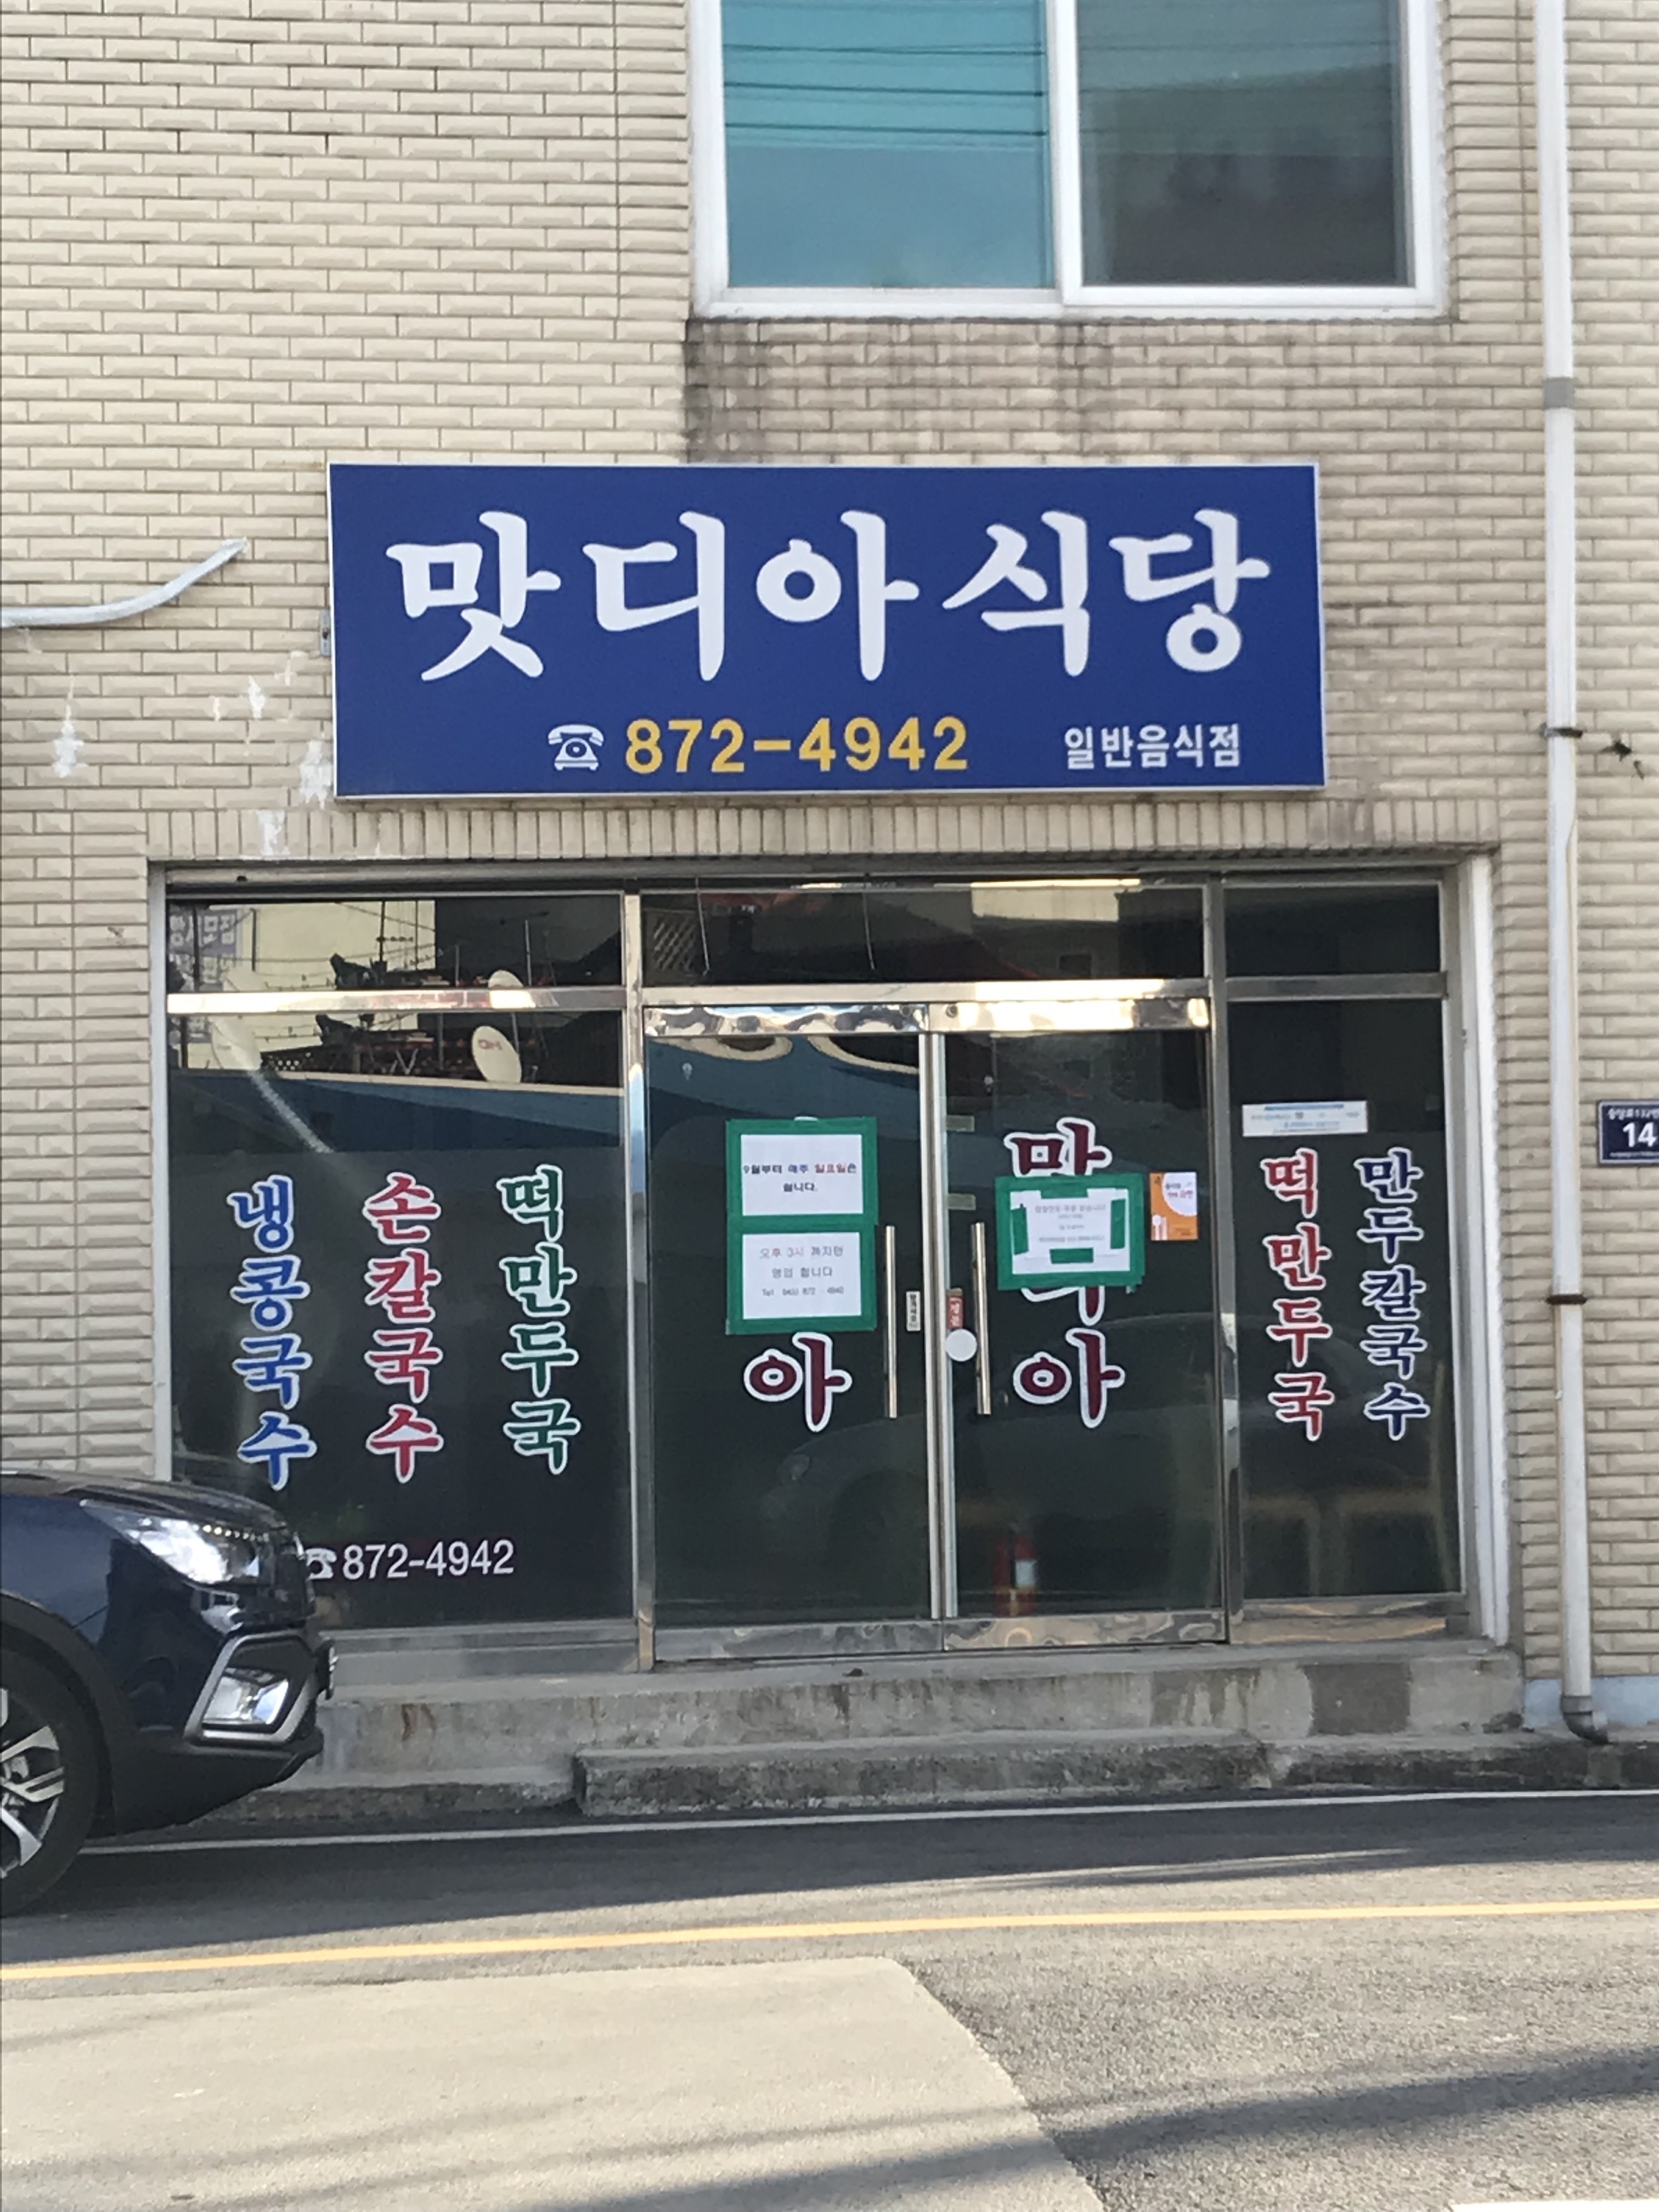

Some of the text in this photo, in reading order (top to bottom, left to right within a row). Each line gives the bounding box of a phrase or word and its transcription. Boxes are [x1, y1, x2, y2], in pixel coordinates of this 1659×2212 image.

[625, 715, 968, 774] 872-4942
[1064, 723, 1240, 769] 일반음식점
[1622, 1122, 1657, 1147] 14
[227, 1175, 317, 1491] 냉콩국수
[363, 1172, 443, 1482] 손칼국수
[496, 1164, 580, 1475] 떡만두국
[1261, 1147, 1334, 1442] 떡만두국
[1353, 1147, 1431, 1441] 만두칼국수
[342, 1539, 514, 1580] 872-4942
